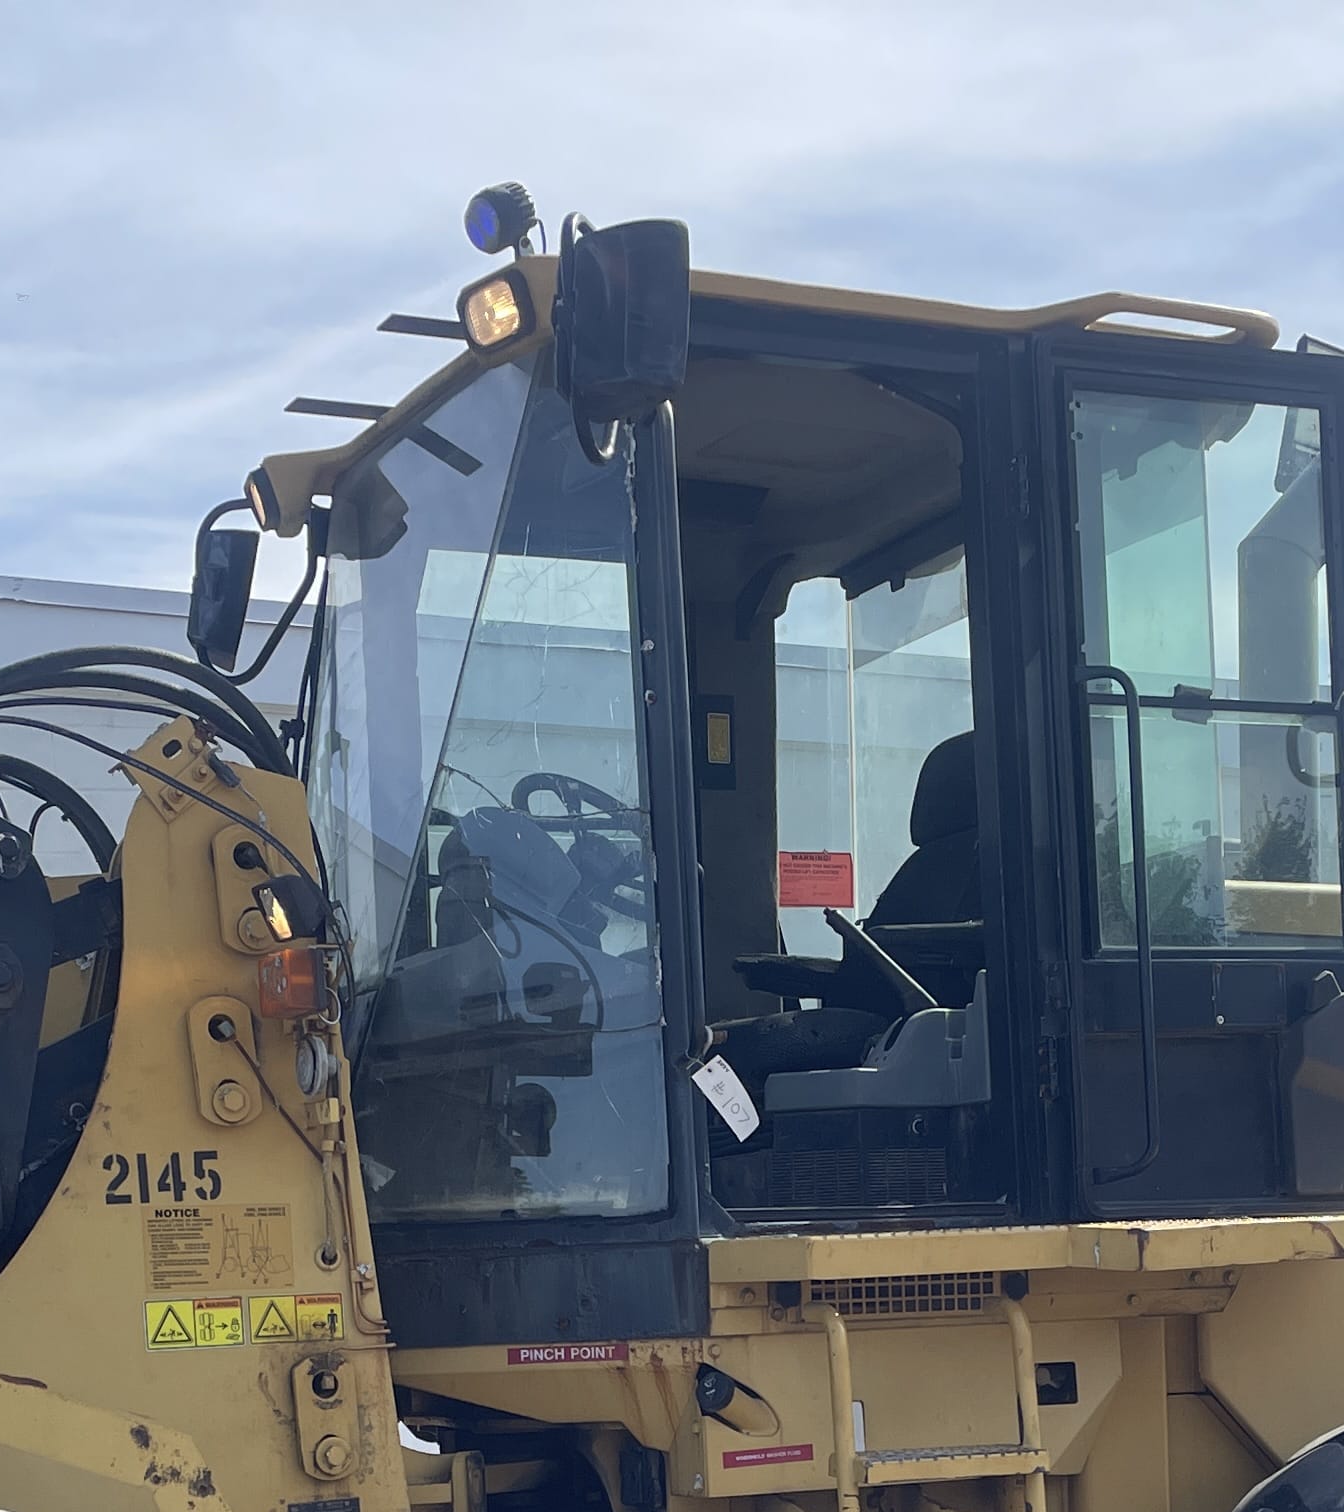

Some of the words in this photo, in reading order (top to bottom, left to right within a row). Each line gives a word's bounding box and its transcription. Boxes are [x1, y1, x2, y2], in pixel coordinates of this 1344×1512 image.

[102, 1150, 222, 1205] 2145
[154, 1208, 201, 1219] NOTICE
[520, 1348, 565, 1362] PINCH
[570, 1346, 616, 1360] POINT
